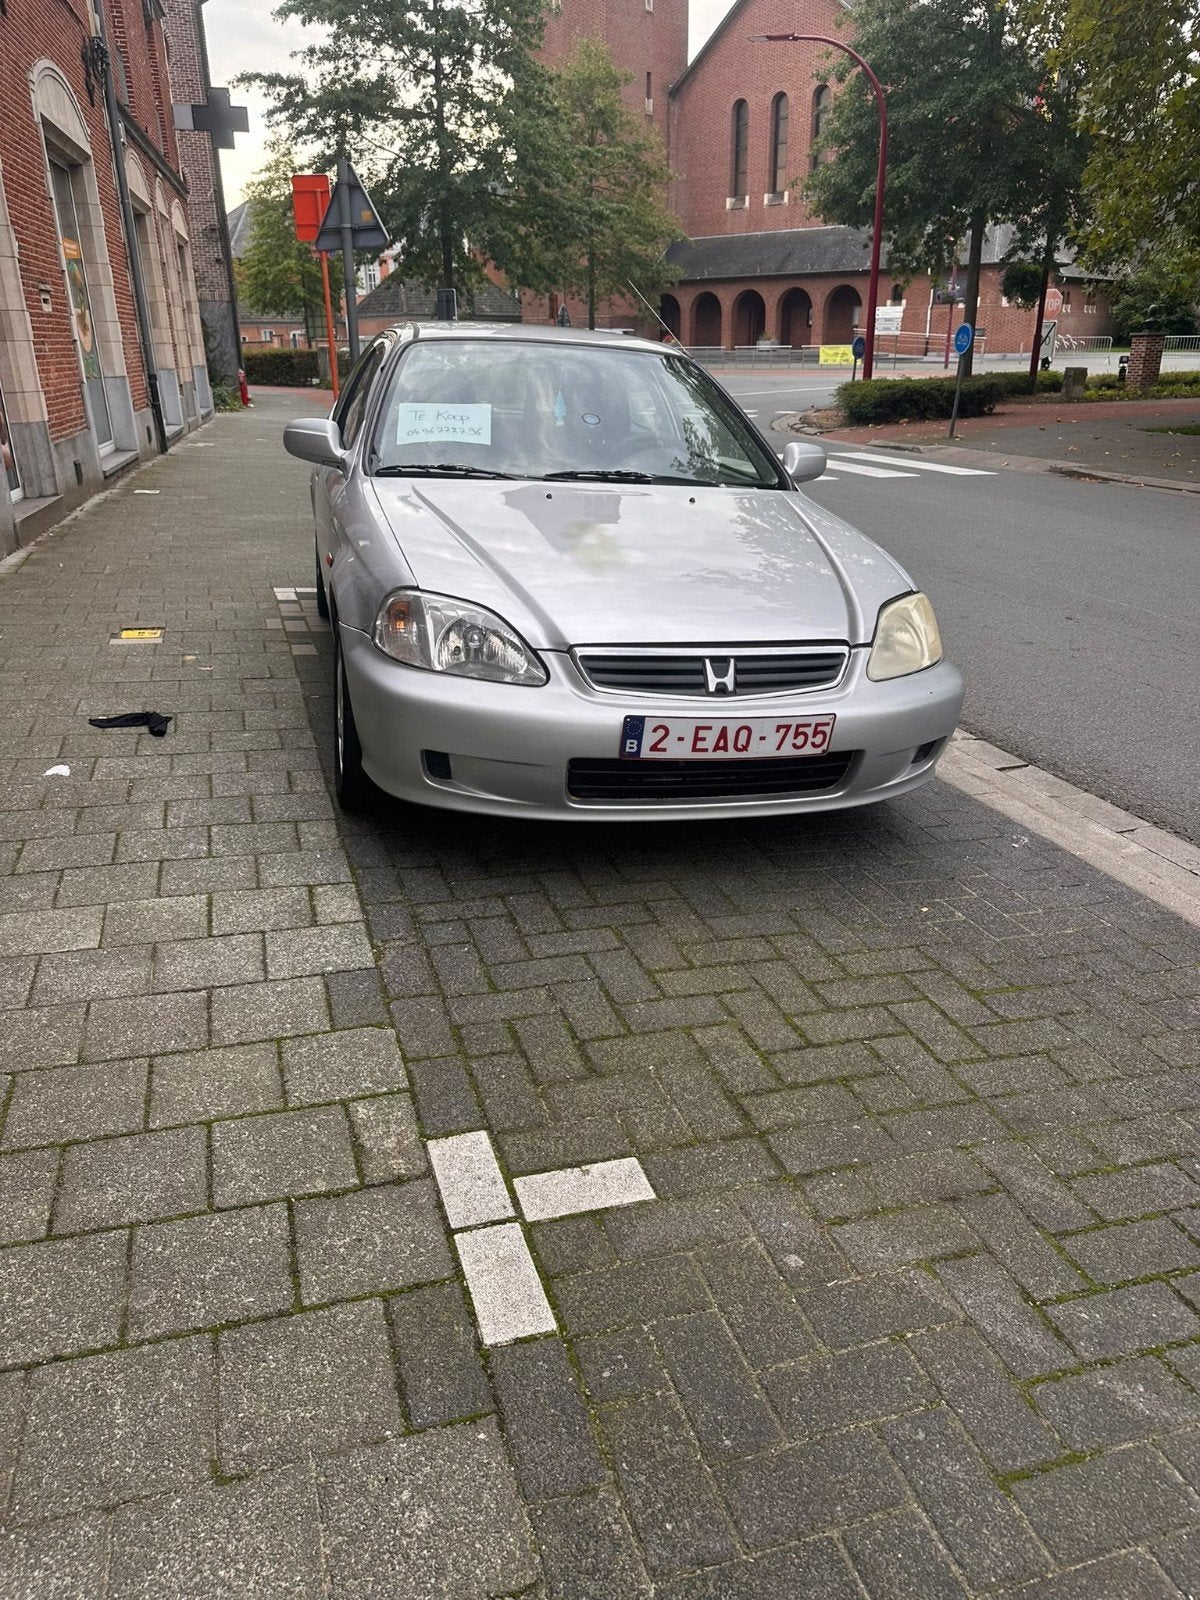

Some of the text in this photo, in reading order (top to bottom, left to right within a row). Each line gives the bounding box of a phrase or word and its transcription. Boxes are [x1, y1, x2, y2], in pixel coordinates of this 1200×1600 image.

[436, 410, 470, 424] Koop
[625, 721, 831, 753] B 2-EAQ-755
